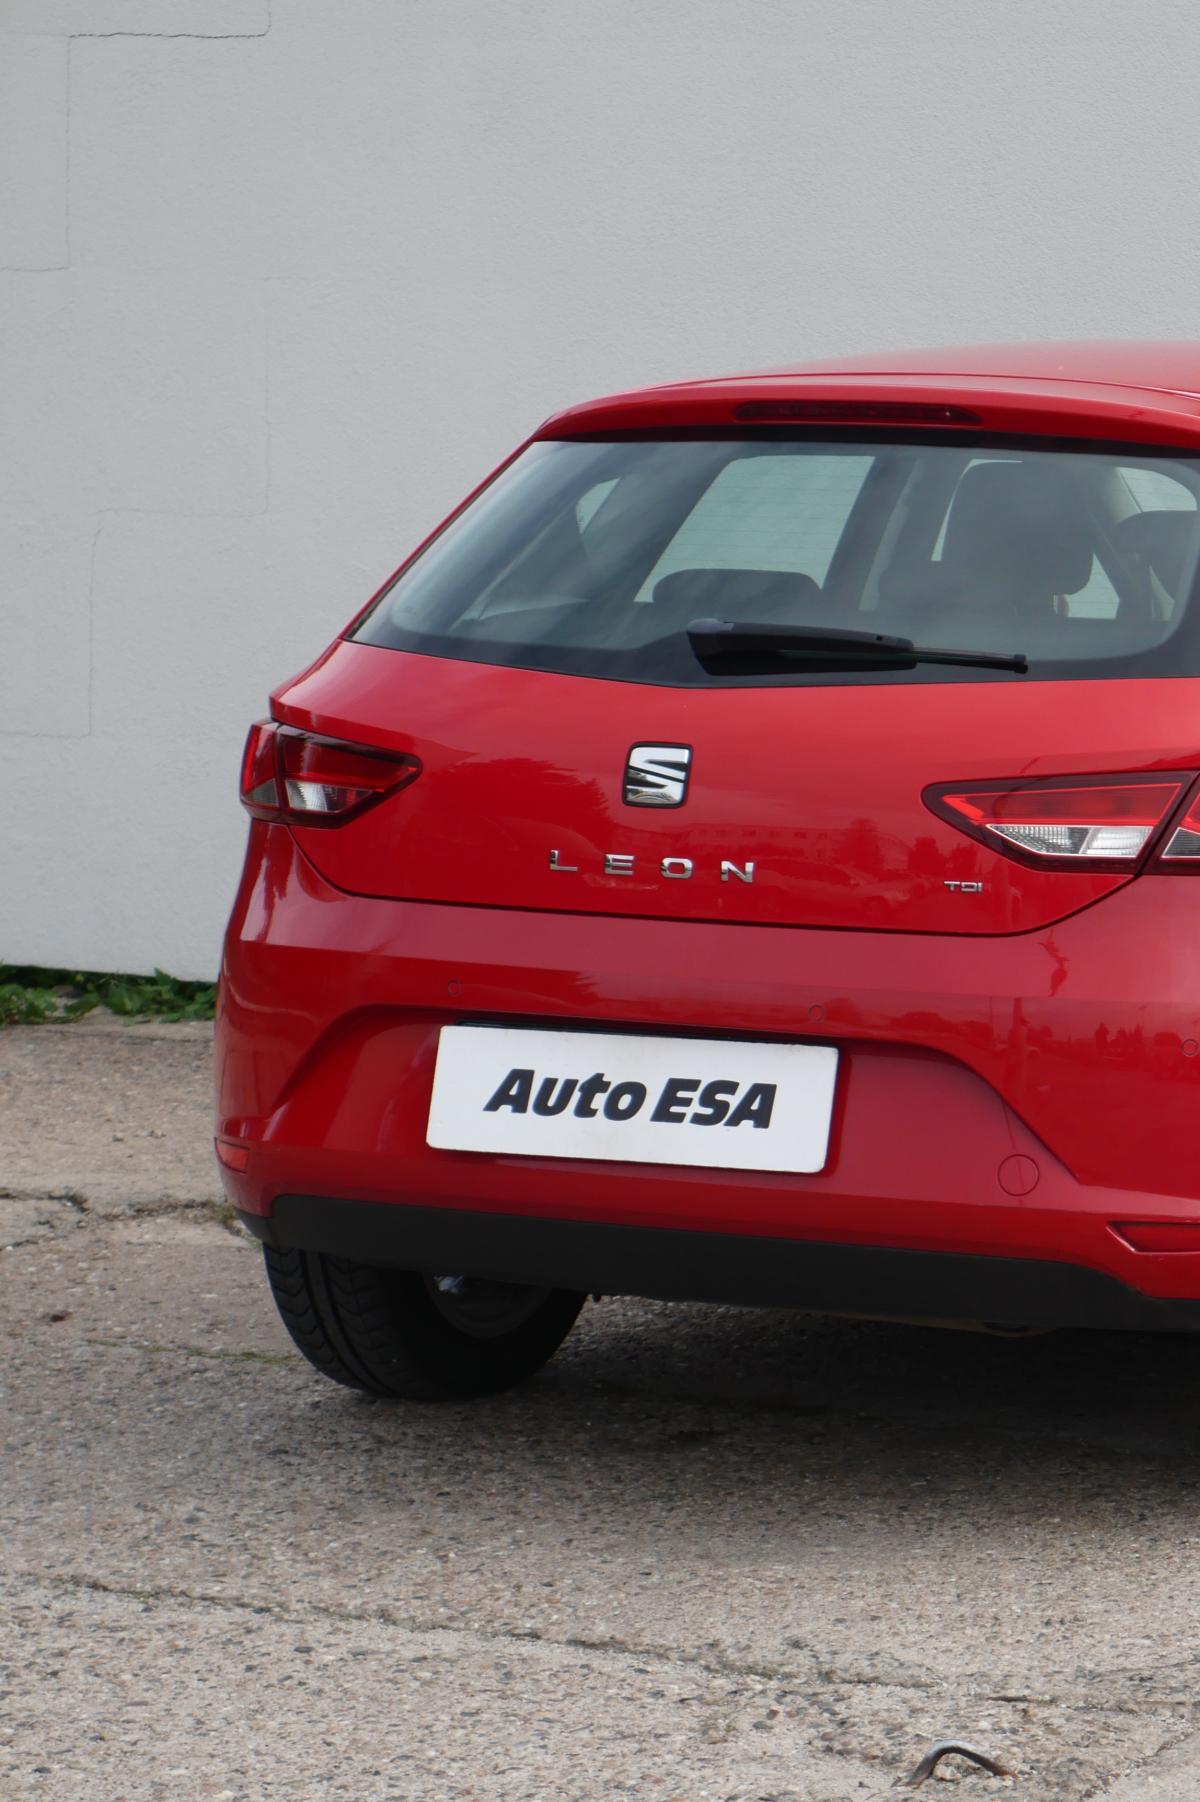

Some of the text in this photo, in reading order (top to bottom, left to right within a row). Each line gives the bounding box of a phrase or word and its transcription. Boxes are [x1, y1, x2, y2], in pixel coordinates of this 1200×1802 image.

[549, 849, 755, 884] LEON
[943, 881, 983, 893] TDI
[482, 1068, 778, 1130] Auto ESA
